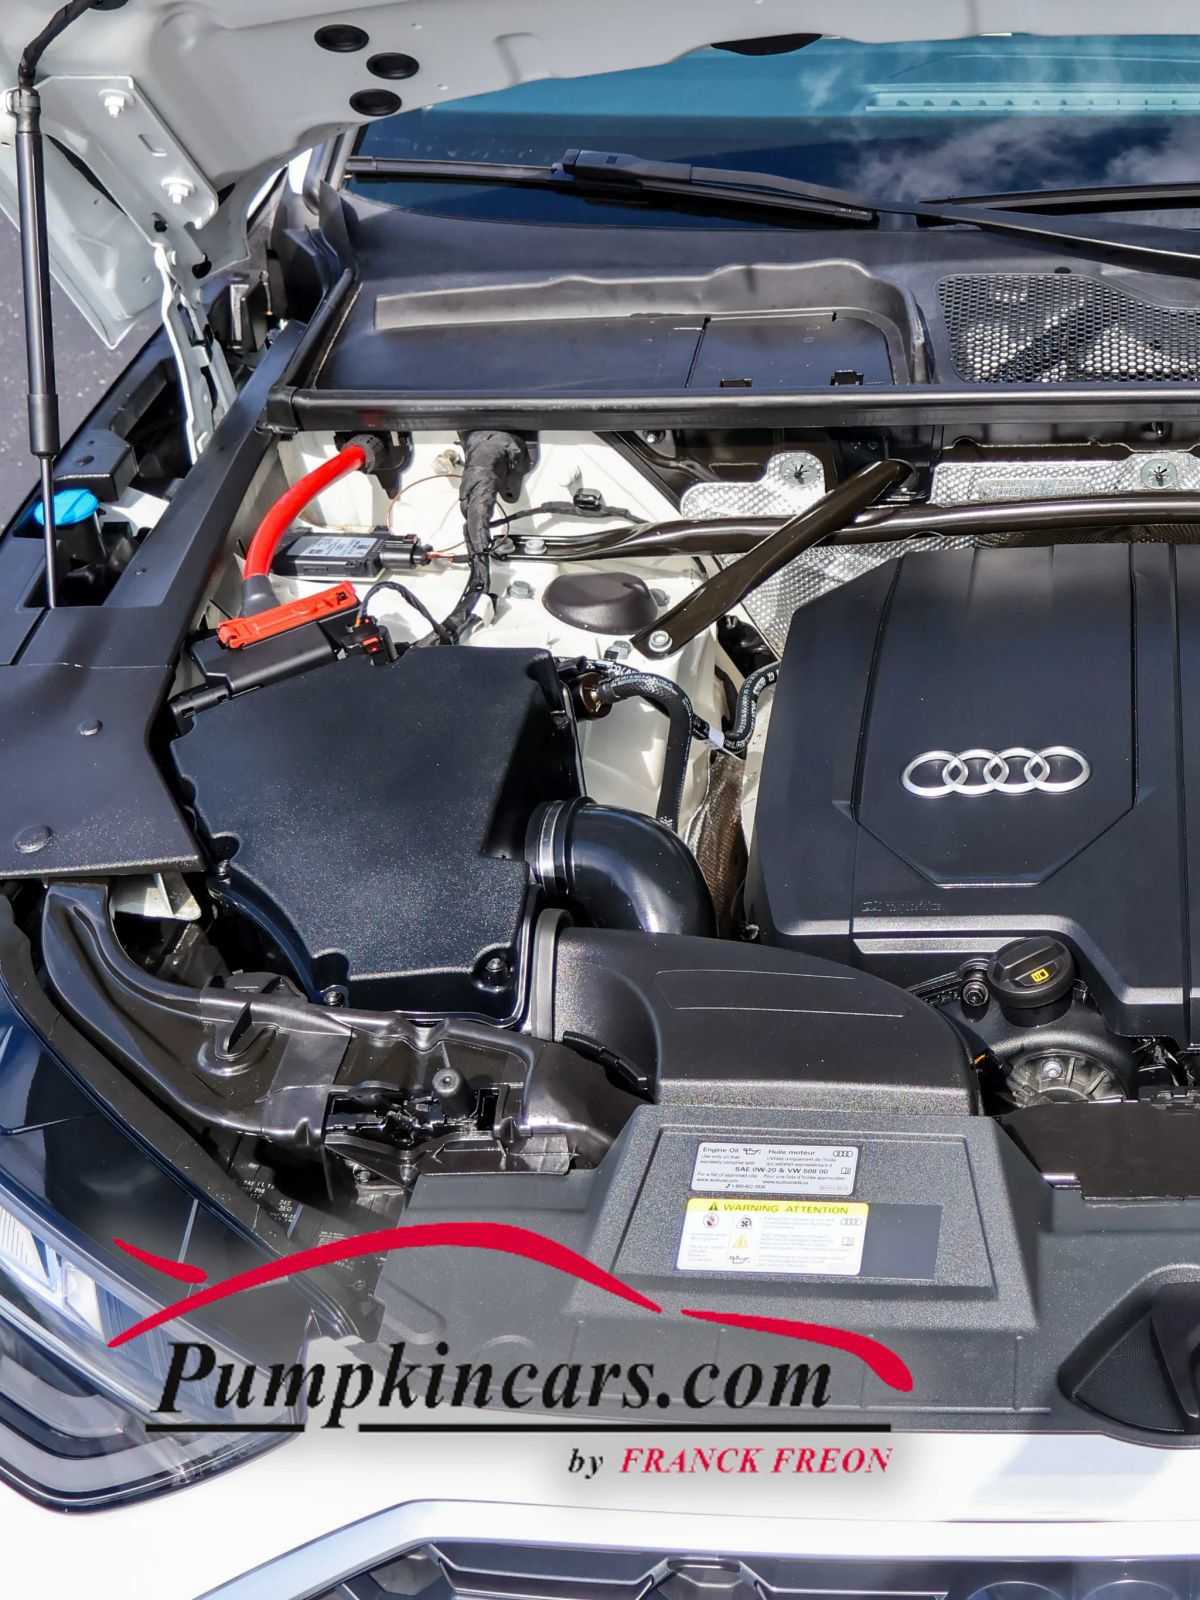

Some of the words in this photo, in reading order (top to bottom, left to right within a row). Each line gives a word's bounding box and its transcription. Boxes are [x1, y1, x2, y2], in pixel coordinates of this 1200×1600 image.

[702, 1146, 727, 1154] Engine
[723, 1204, 779, 1212] WARNING
[785, 1205, 849, 1214] ATTENTION
